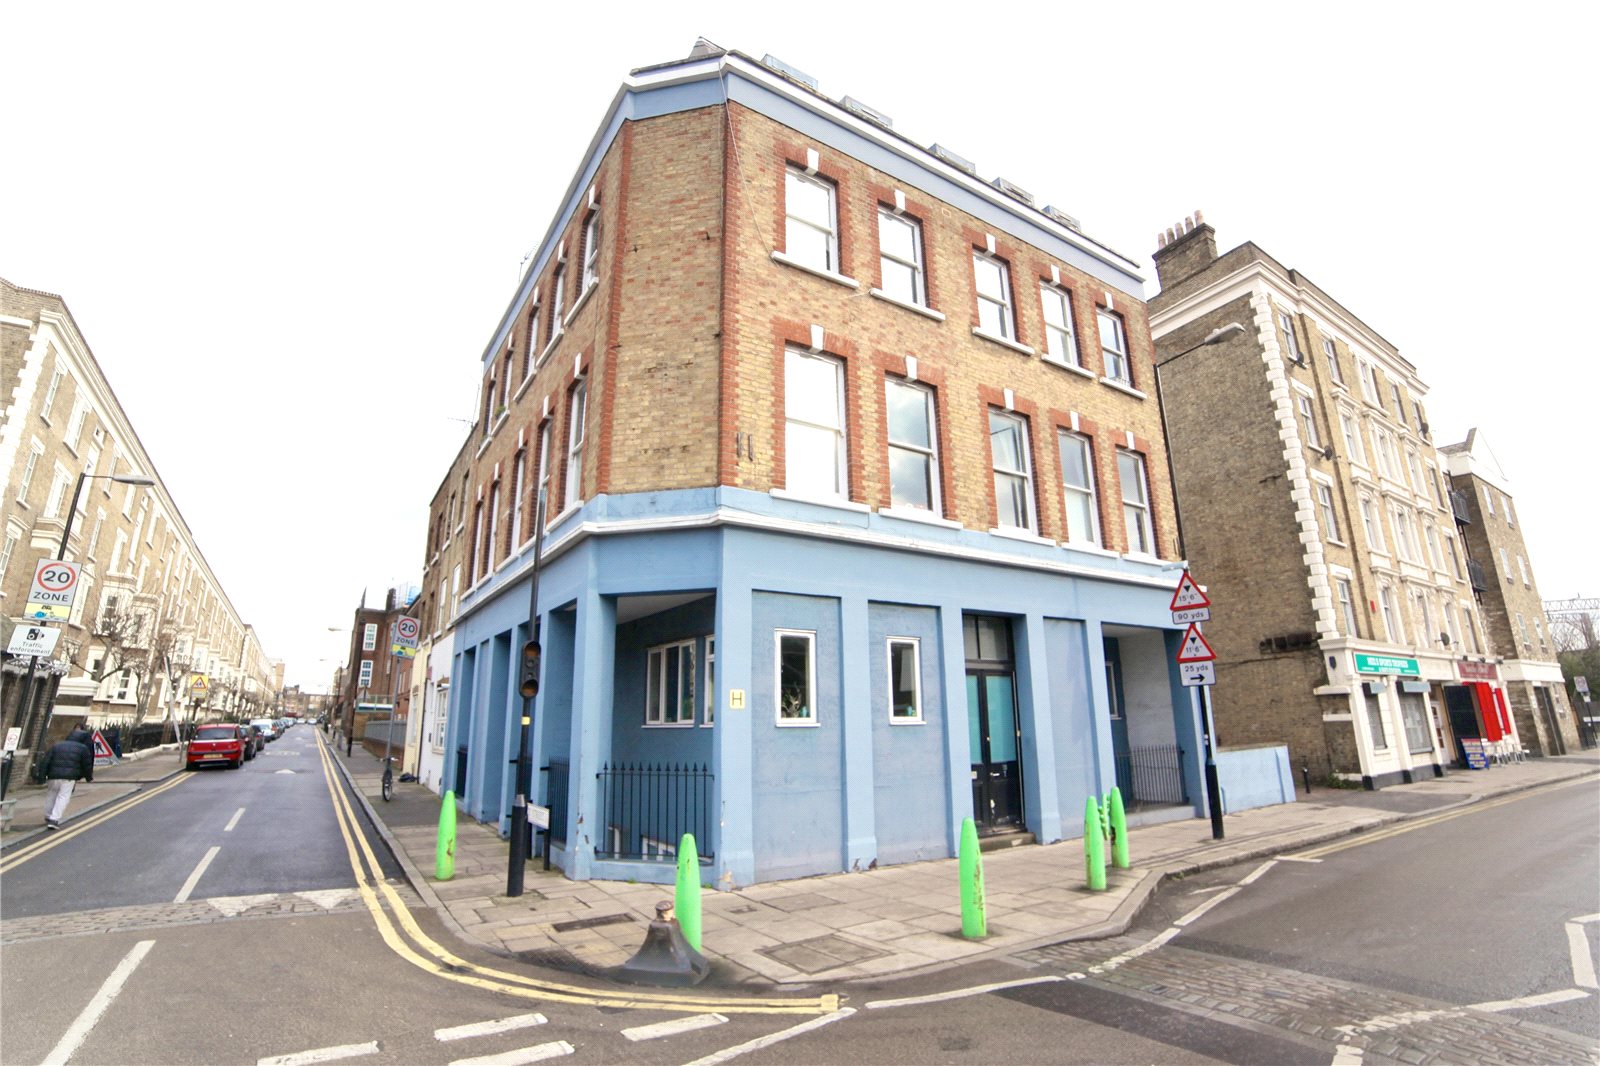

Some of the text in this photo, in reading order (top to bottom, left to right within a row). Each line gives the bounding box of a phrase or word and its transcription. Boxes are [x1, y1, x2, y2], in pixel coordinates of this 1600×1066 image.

[44, 570, 70, 584] 20
[33, 591, 69, 602] ZONE
[1178, 611, 1204, 620] 90 yds
[401, 623, 415, 633] 20
[396, 636, 414, 645] ZONE
[1185, 664, 1209, 674] 25 yds
[732, 691, 742, 706] H
